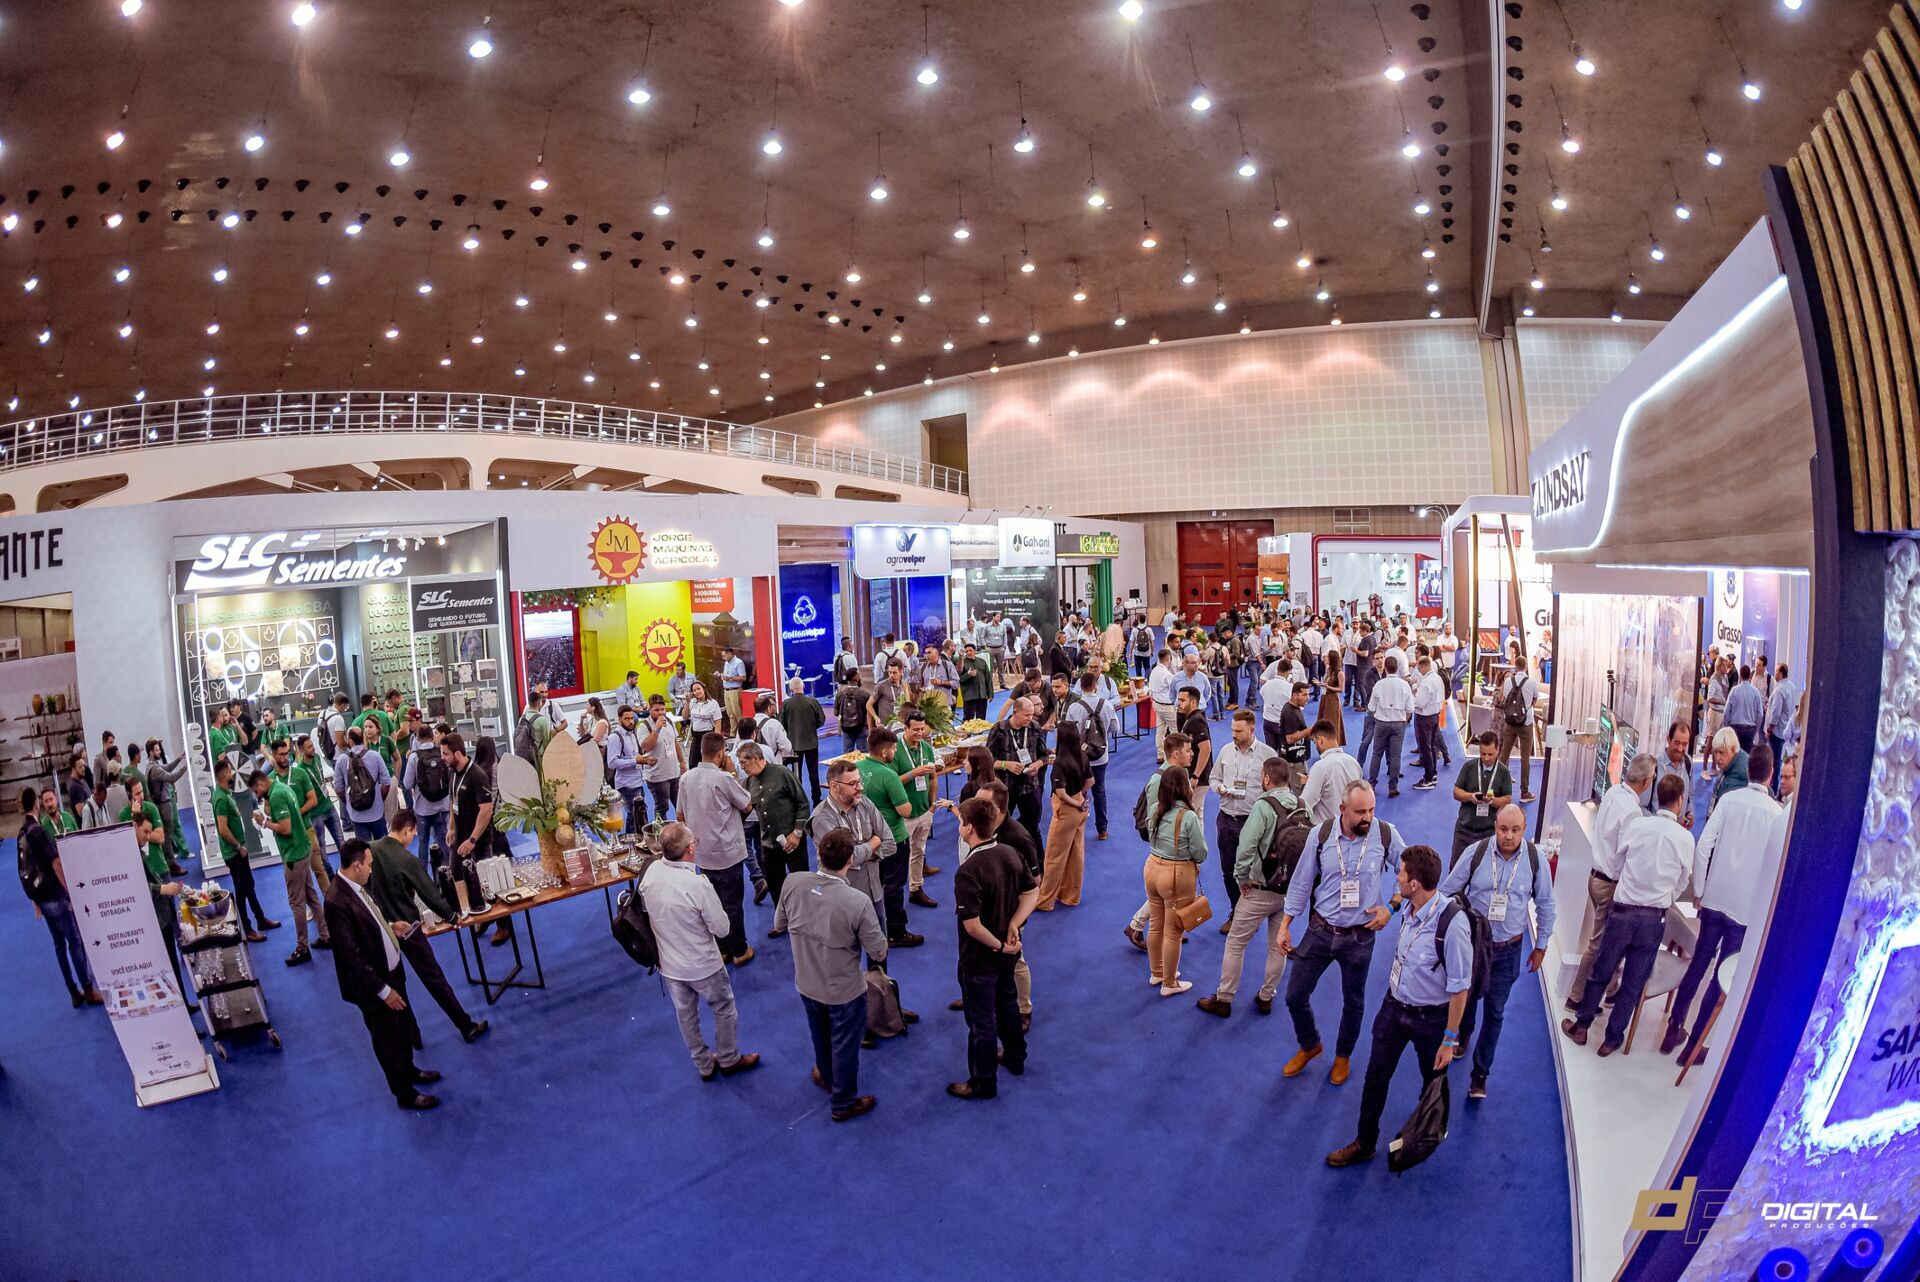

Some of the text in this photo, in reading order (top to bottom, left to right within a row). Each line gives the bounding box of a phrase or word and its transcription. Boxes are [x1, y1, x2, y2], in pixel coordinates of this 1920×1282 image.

[1536, 452, 1587, 517] LINDSAY
[606, 529, 629, 552] JM
[653, 533, 692, 542] JORGE
[1023, 535, 1050, 548] Galvani
[192, 531, 288, 571] SLC
[886, 554, 926, 566] agrovelper
[275, 554, 407, 584] Sementes
[419, 590, 452, 605] SLC
[446, 596, 495, 608] Sementes
[654, 629, 672, 648] JM
[91, 873, 129, 886] COFFEE BREAK
[97, 896, 136, 909] RESTAURANTE
[100, 907, 125, 918] ENTRADA
[107, 928, 145, 941] RESTAURANTE
[109, 938, 135, 950] ENTRADA
[111, 961, 153, 976] VOCÊ ESTÁ AQUI
